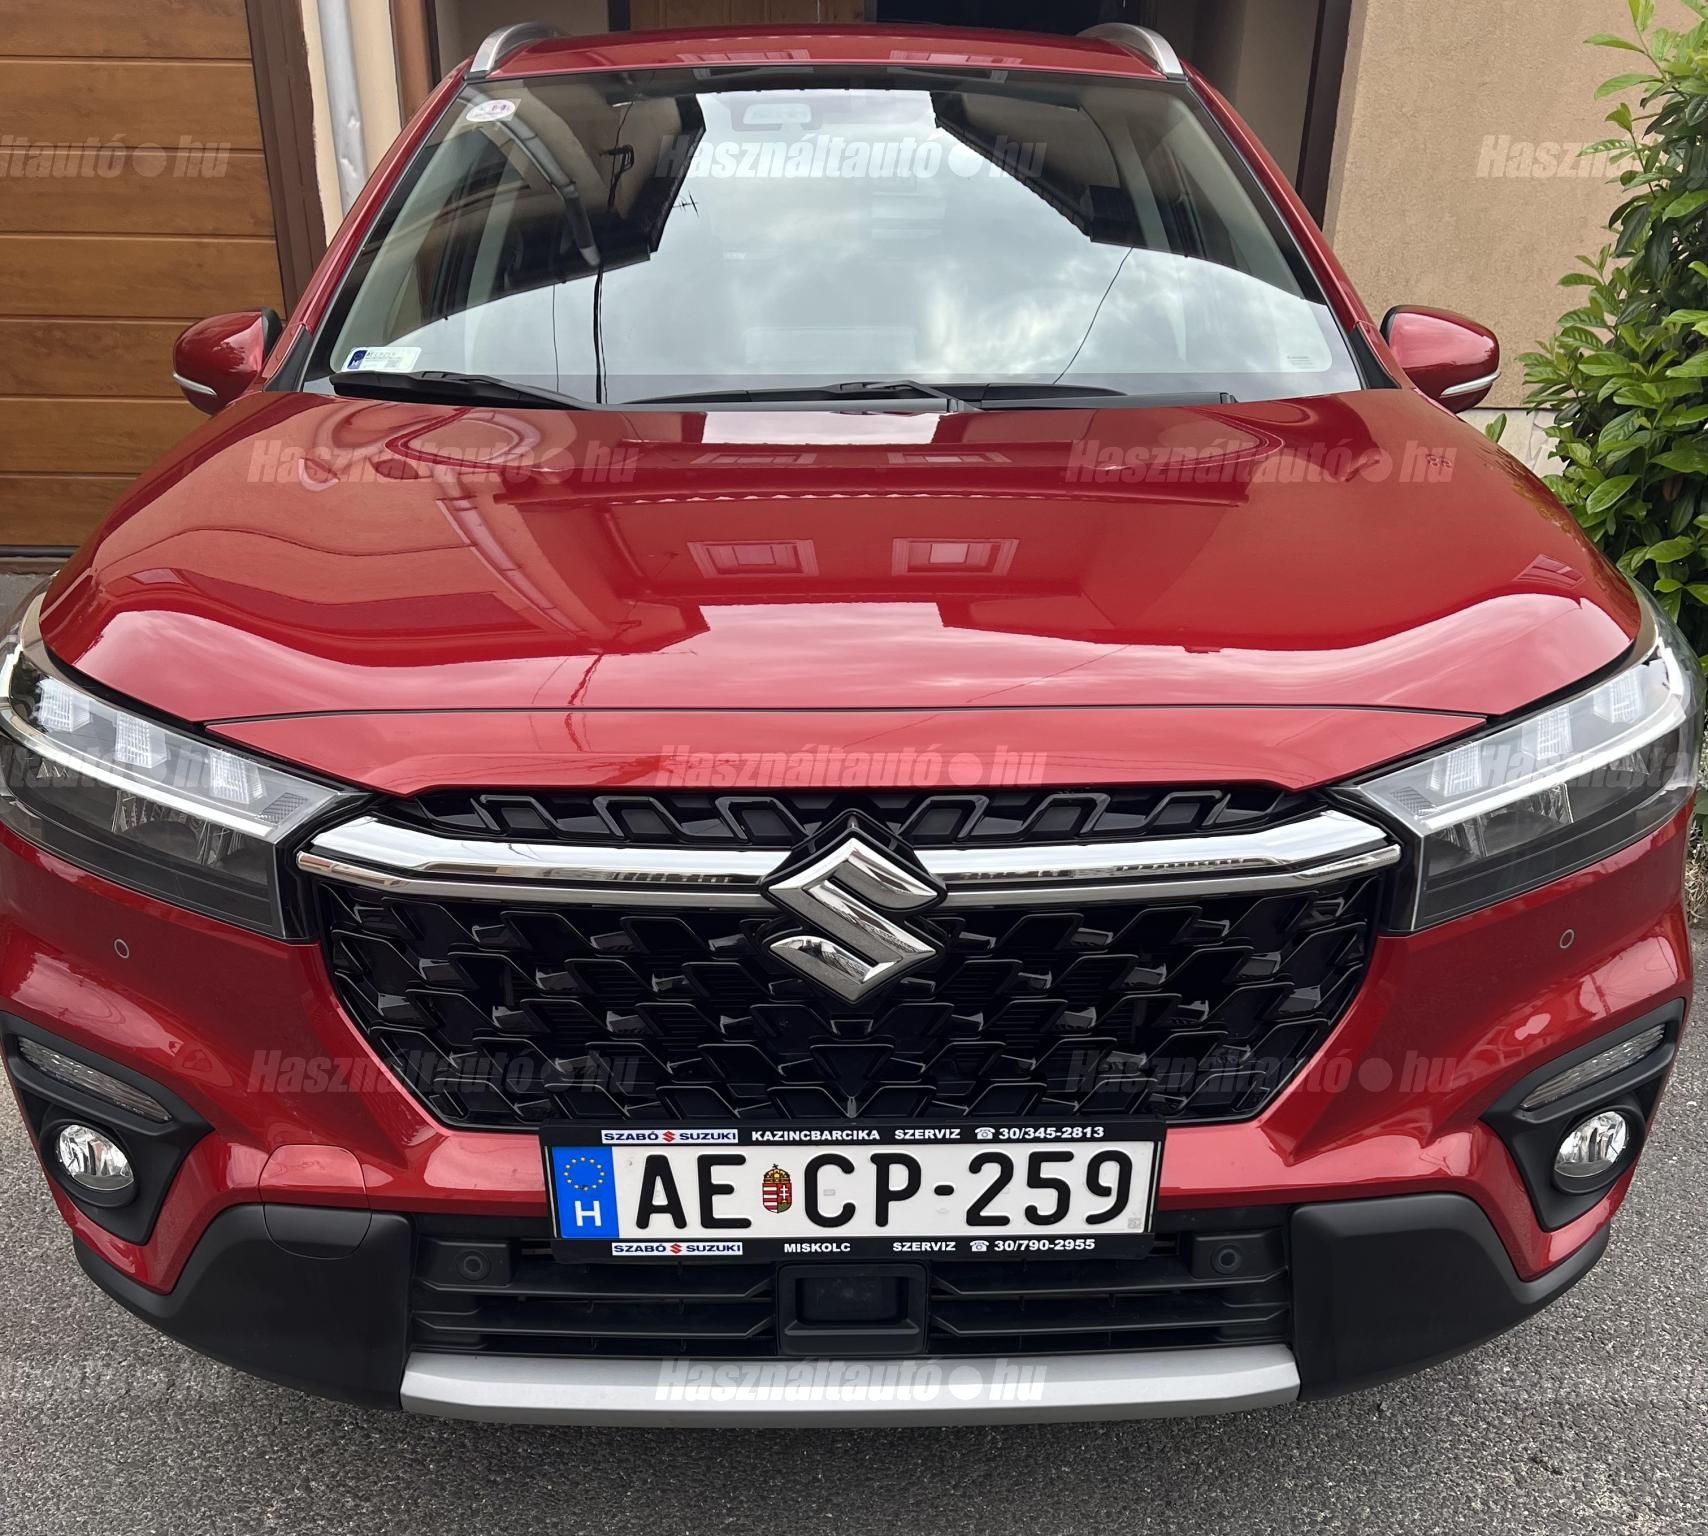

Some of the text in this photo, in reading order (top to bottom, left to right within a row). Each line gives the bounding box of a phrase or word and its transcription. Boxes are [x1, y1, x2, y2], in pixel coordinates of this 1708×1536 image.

[604, 1126, 1105, 1142] SZABÓ SUZUKI KAZINCBARCIKA SZERVIZ 30/345-2813
[635, 1149, 1133, 1230] AE CP-259
[574, 1200, 602, 1227] H
[613, 1238, 1096, 1253] SZABÓ SUZUKI MISKOLC SZERVIZ 30/790-2955
